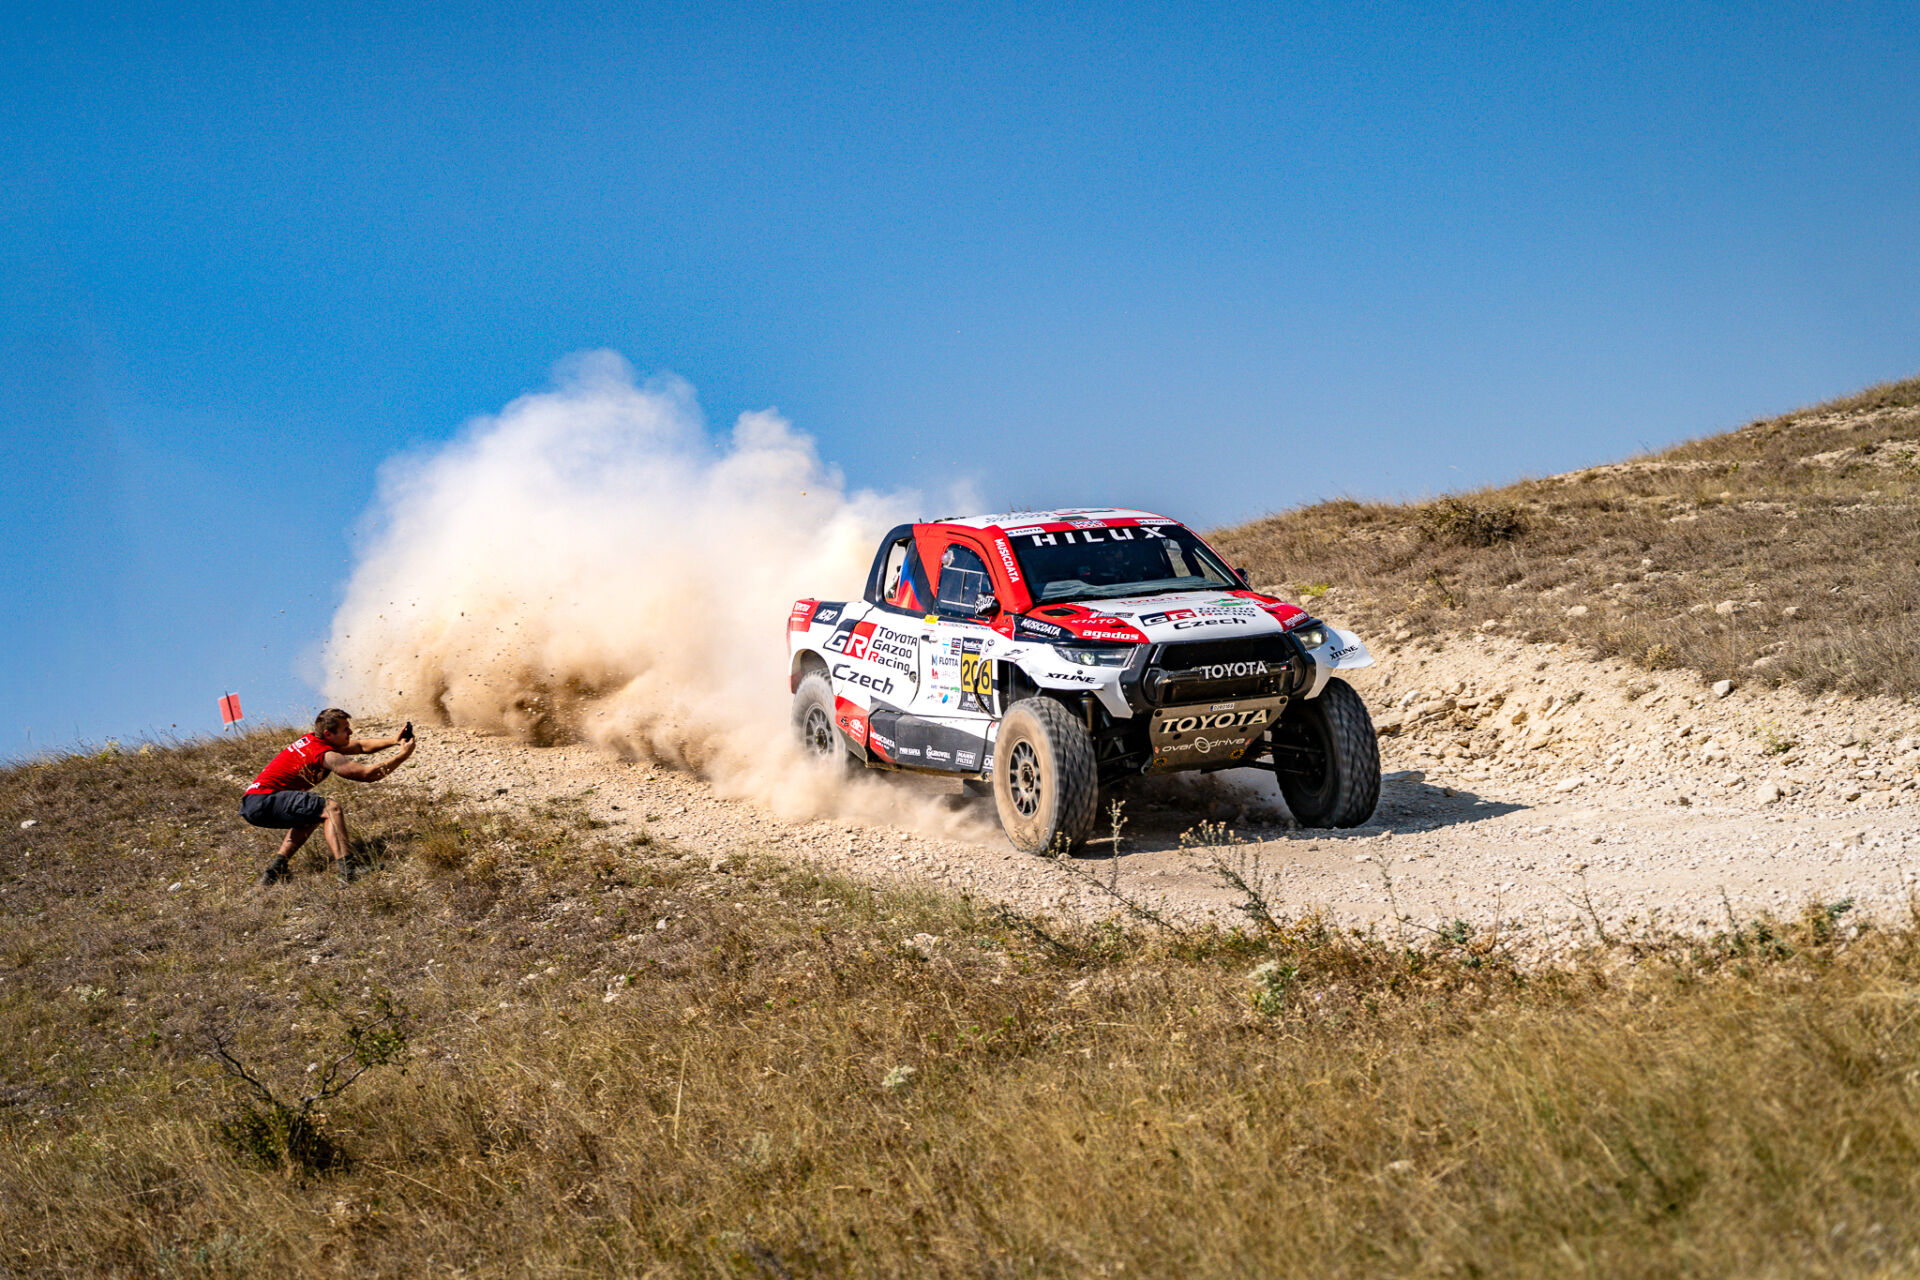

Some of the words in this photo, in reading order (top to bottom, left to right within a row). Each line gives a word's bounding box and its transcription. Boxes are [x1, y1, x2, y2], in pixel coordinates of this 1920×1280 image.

[1031, 526, 1167, 547] HILUX
[994, 538, 1020, 583] MUSICDATA
[1020, 618, 1062, 636] MUSICDATA
[1141, 611, 1196, 625] GR
[1173, 617, 1247, 630] Czech
[823, 628, 870, 659] GR
[879, 626, 918, 647] TOYOTA
[1081, 629, 1140, 641] agados
[872, 639, 912, 659] GAZOO
[868, 651, 910, 676] Racing
[939, 656, 959, 667] FLOTTA
[1202, 660, 1268, 680] TOYOTA
[832, 663, 894, 695] Czech
[1046, 673, 1096, 684] XTLINE
[1162, 709, 1268, 734] TOYOTA
